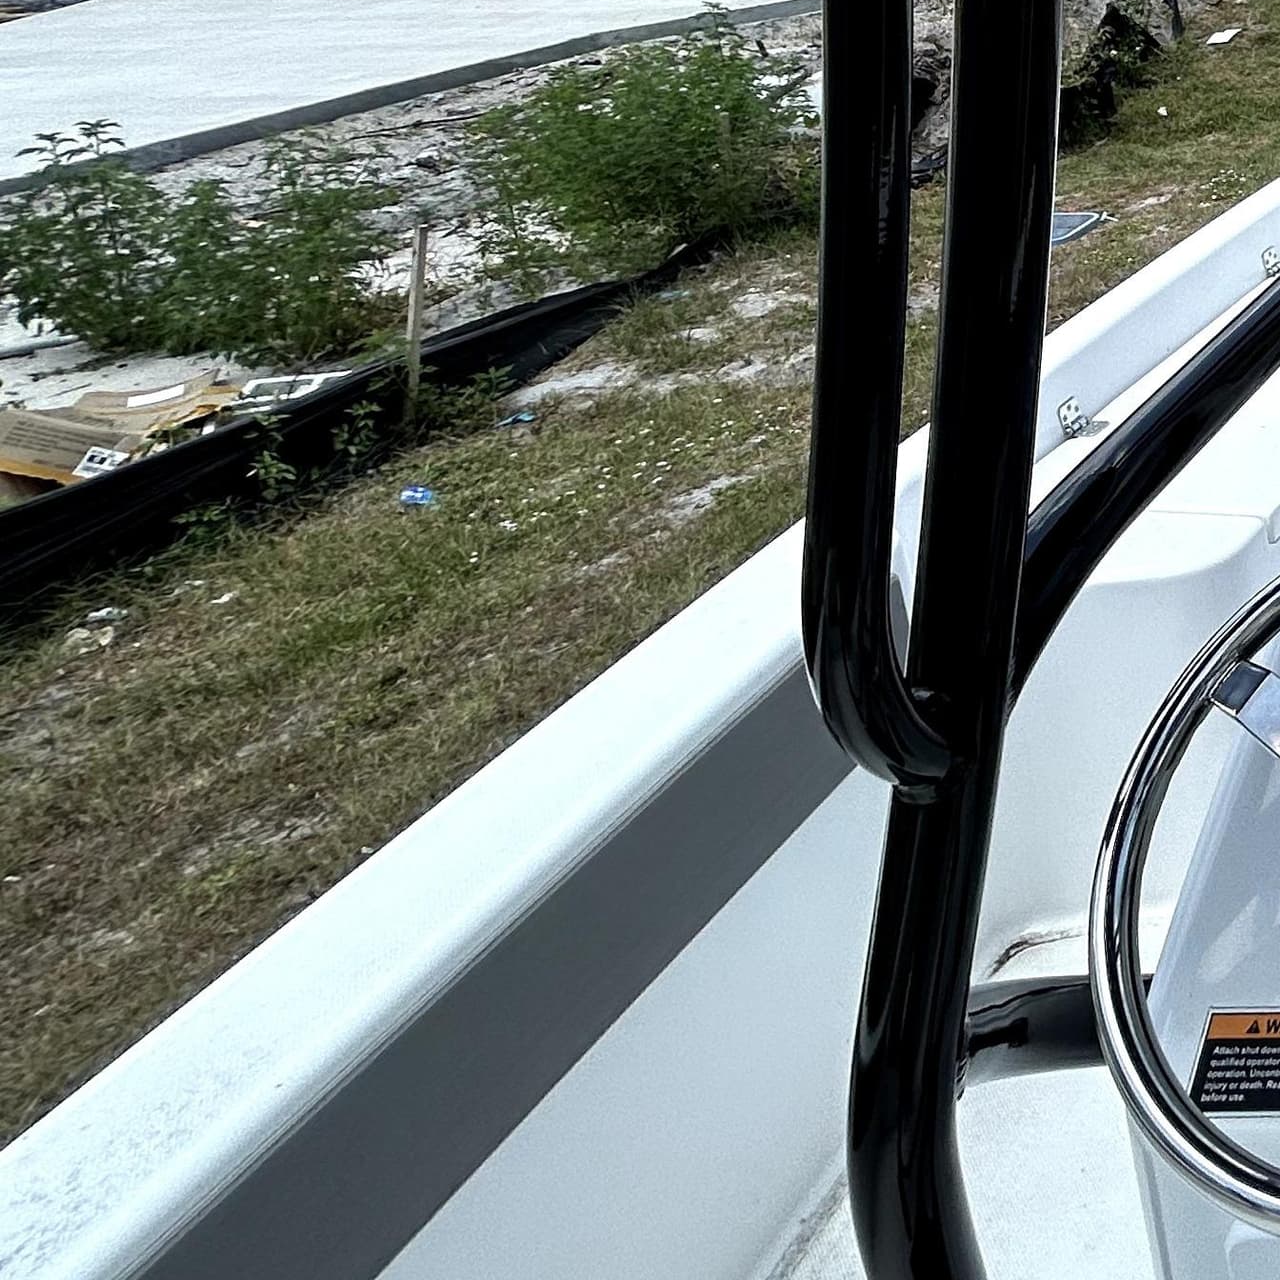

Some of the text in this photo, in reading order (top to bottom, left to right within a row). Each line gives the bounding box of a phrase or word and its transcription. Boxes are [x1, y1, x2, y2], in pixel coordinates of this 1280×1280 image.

[1212, 1045, 1240, 1055] Attach
[1241, 1045, 1260, 1055] shut
[1210, 1057, 1246, 1068] qualified
[1246, 1058, 1280, 1068] operator
[1207, 1069, 1247, 1080] operation.
[1203, 1080, 1228, 1092] injury
[1228, 1082, 1239, 1090] or
[1239, 1080, 1264, 1090] death.
[1200, 1093, 1228, 1103] before
